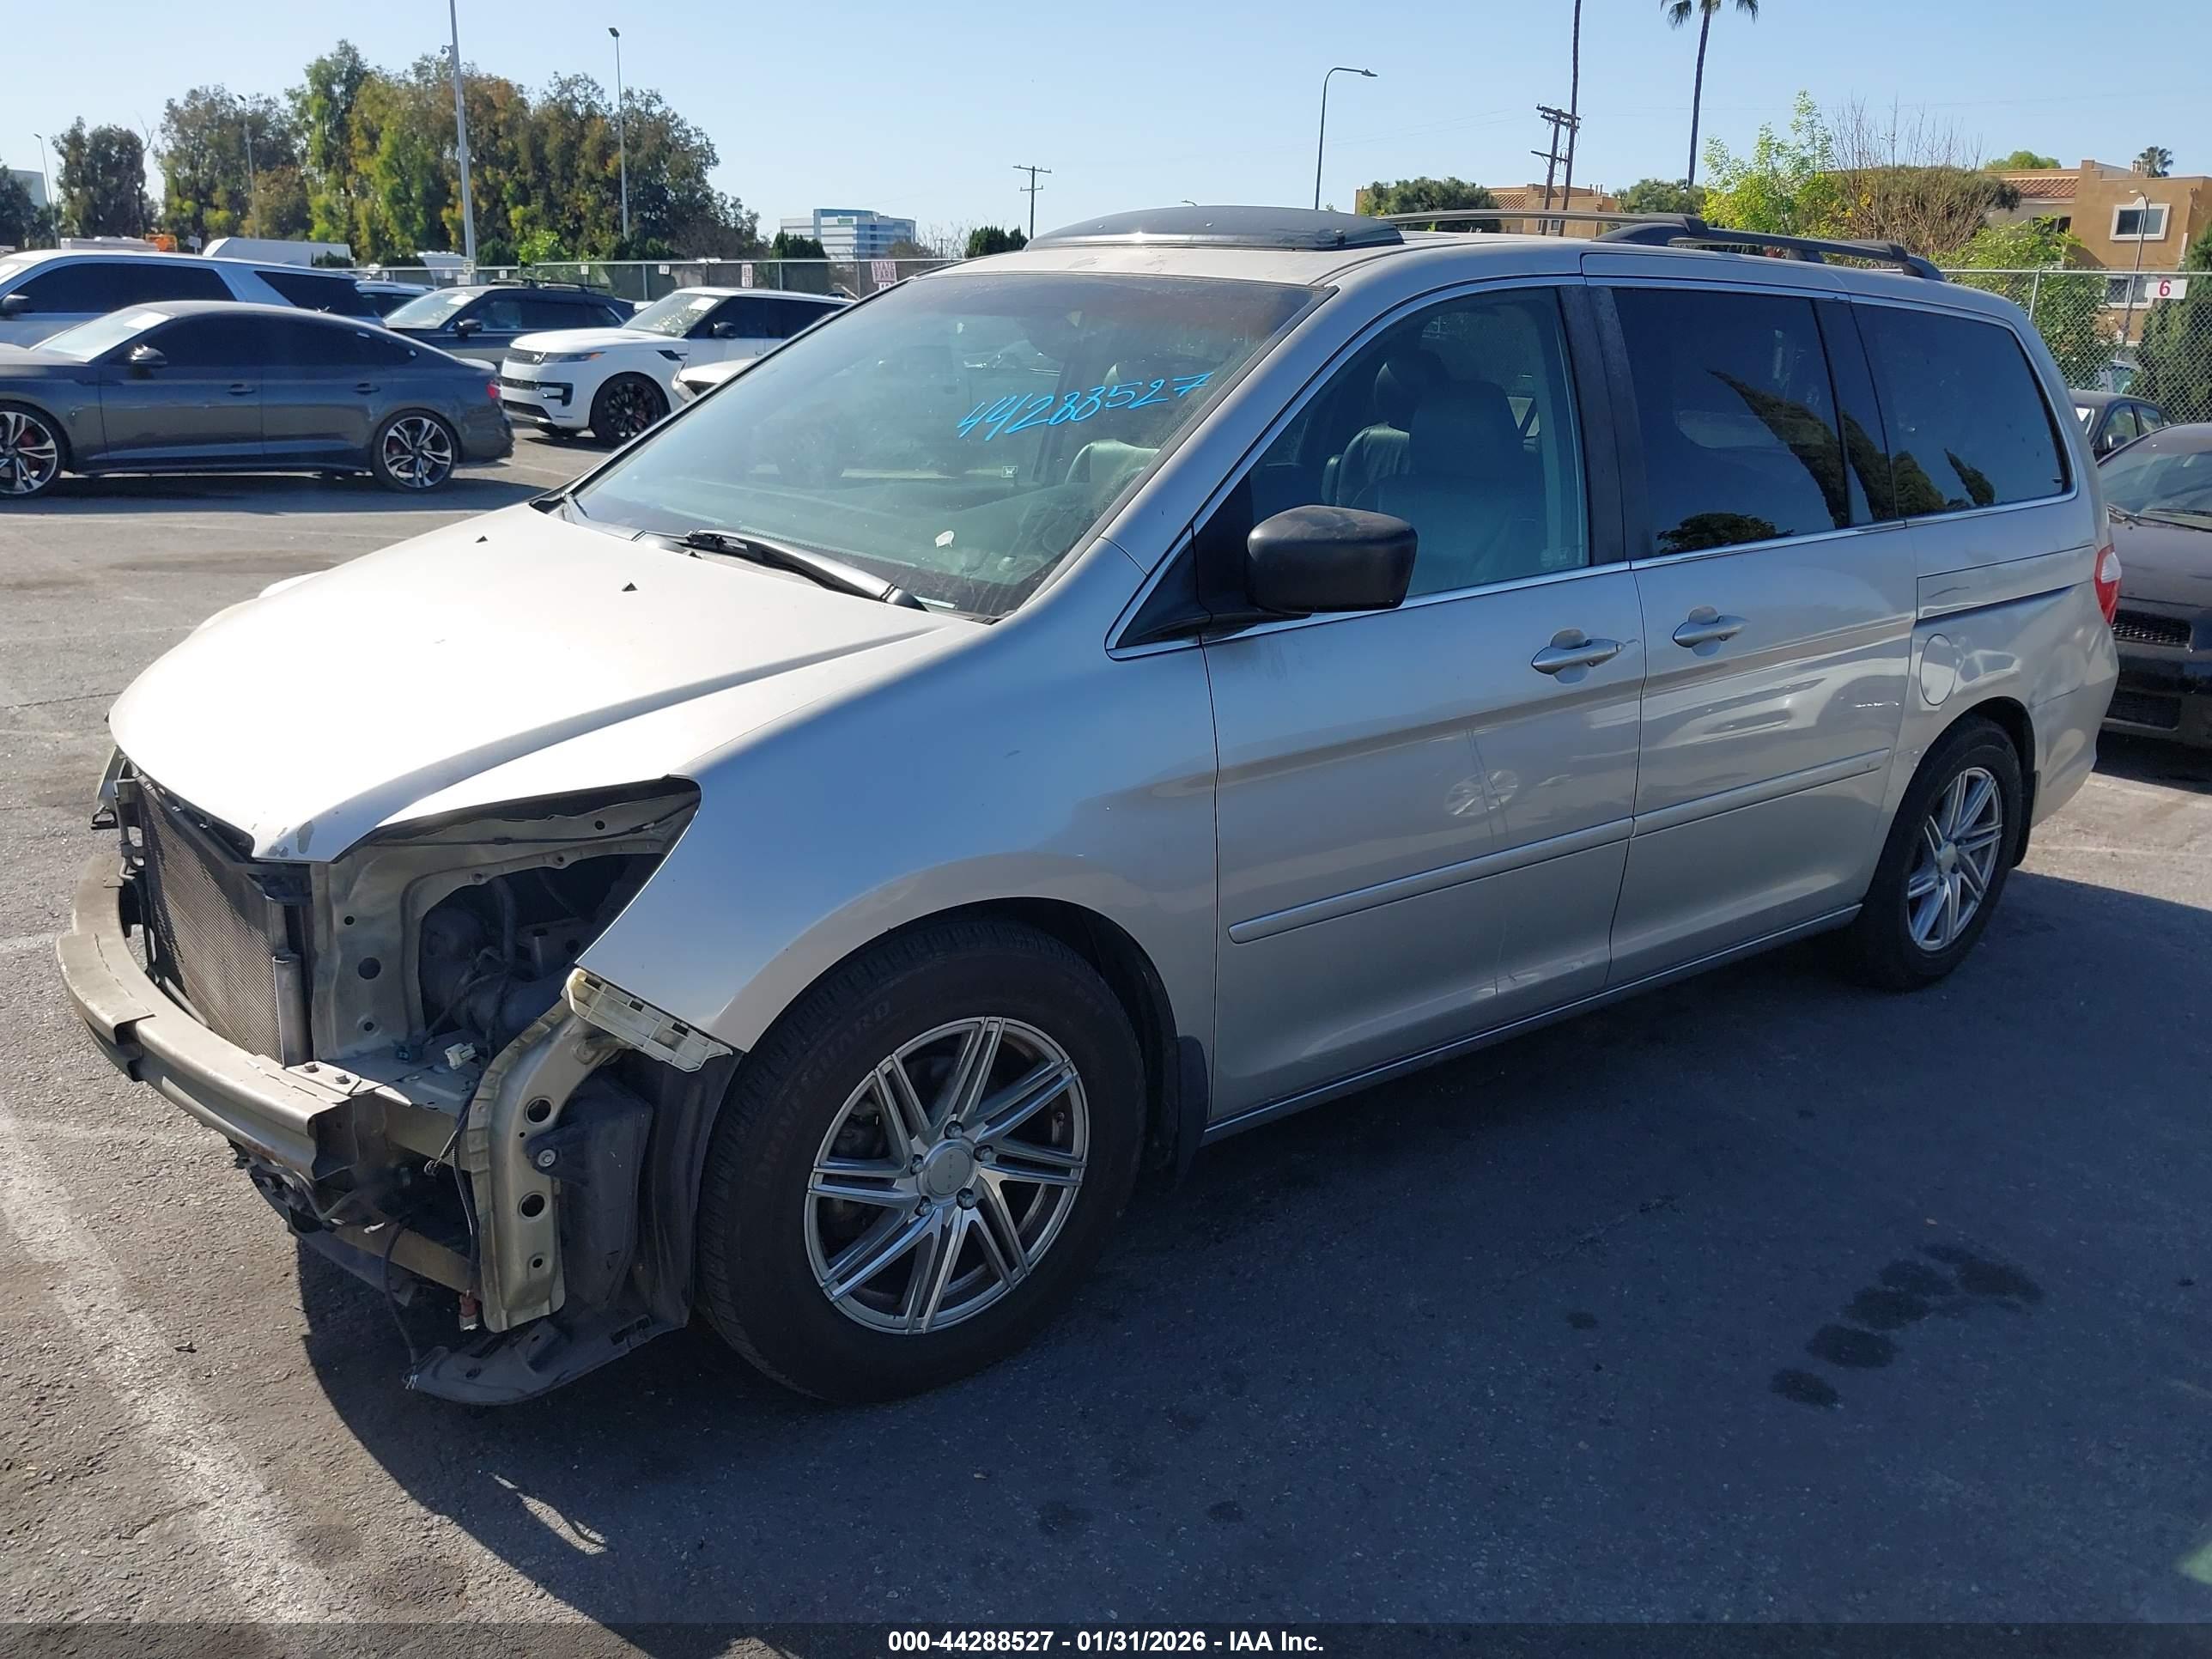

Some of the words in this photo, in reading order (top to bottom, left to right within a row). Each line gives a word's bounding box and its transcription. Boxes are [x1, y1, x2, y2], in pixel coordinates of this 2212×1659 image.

[872, 261, 895, 270] STATE
[875, 270, 895, 280] FARM
[2159, 279, 2172, 297] 6
[957, 371, 1215, 441] 44288527
